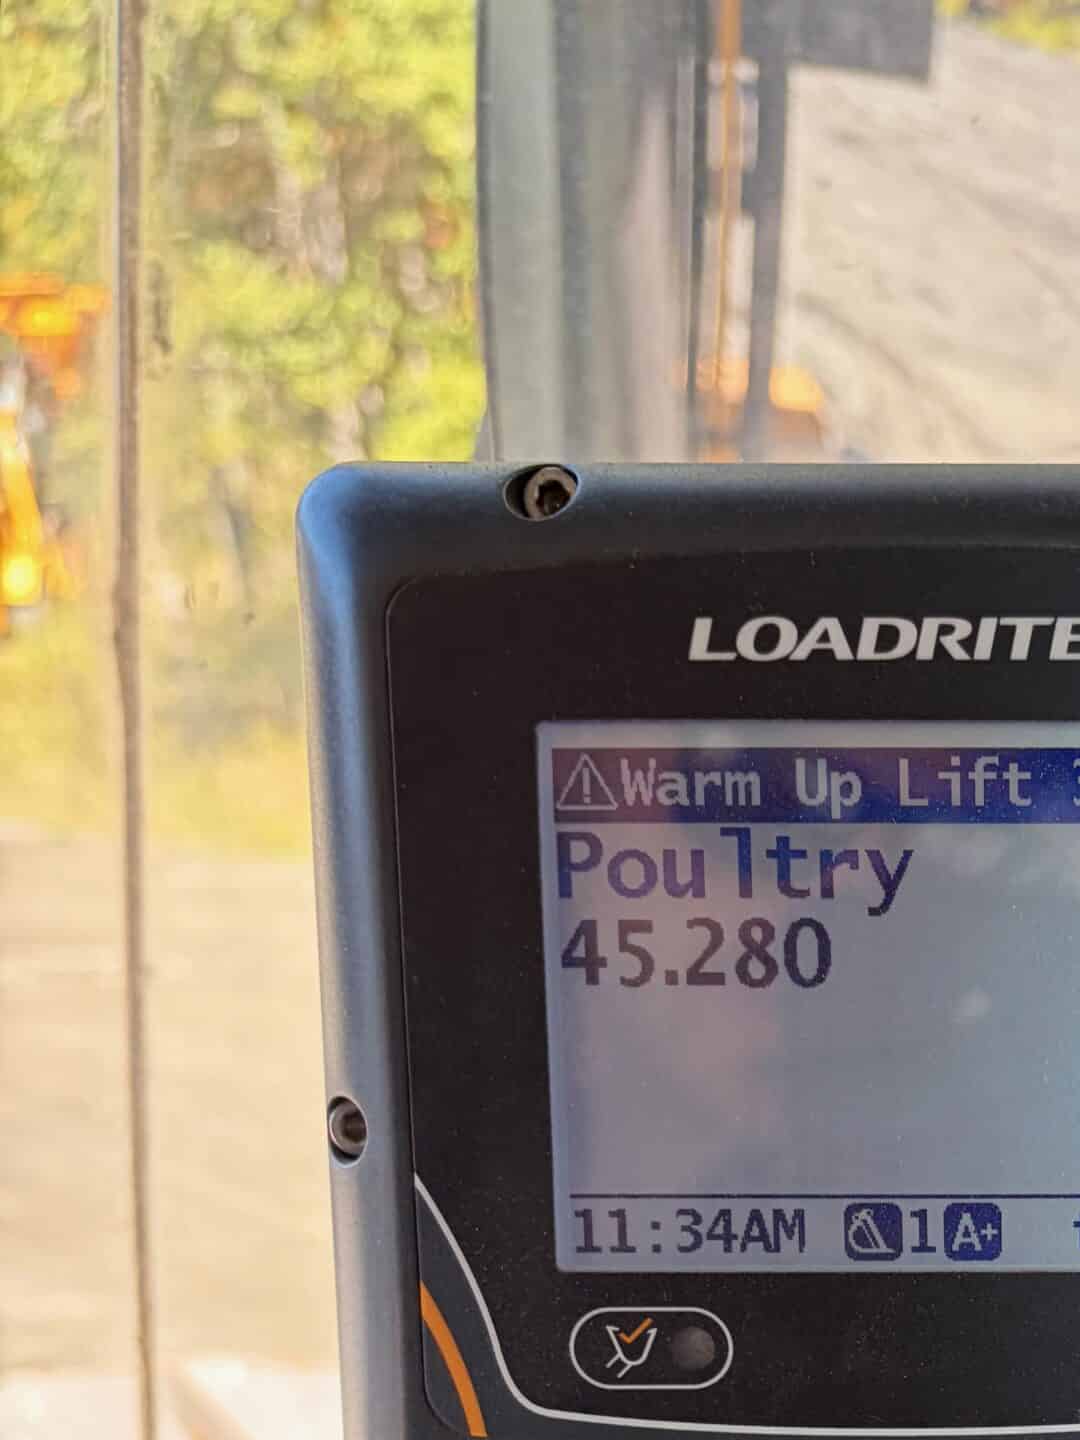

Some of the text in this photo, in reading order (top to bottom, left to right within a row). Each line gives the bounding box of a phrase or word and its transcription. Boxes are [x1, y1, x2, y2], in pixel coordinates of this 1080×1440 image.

[618, 756, 763, 808] Warm
[794, 757, 863, 820] Up
[899, 755, 1034, 808] Lift
[555, 826, 915, 918] Poultry
[559, 916, 833, 990] 45.280
[573, 1208, 806, 1254] 11:34AM
[910, 1208, 938, 1254] 1
